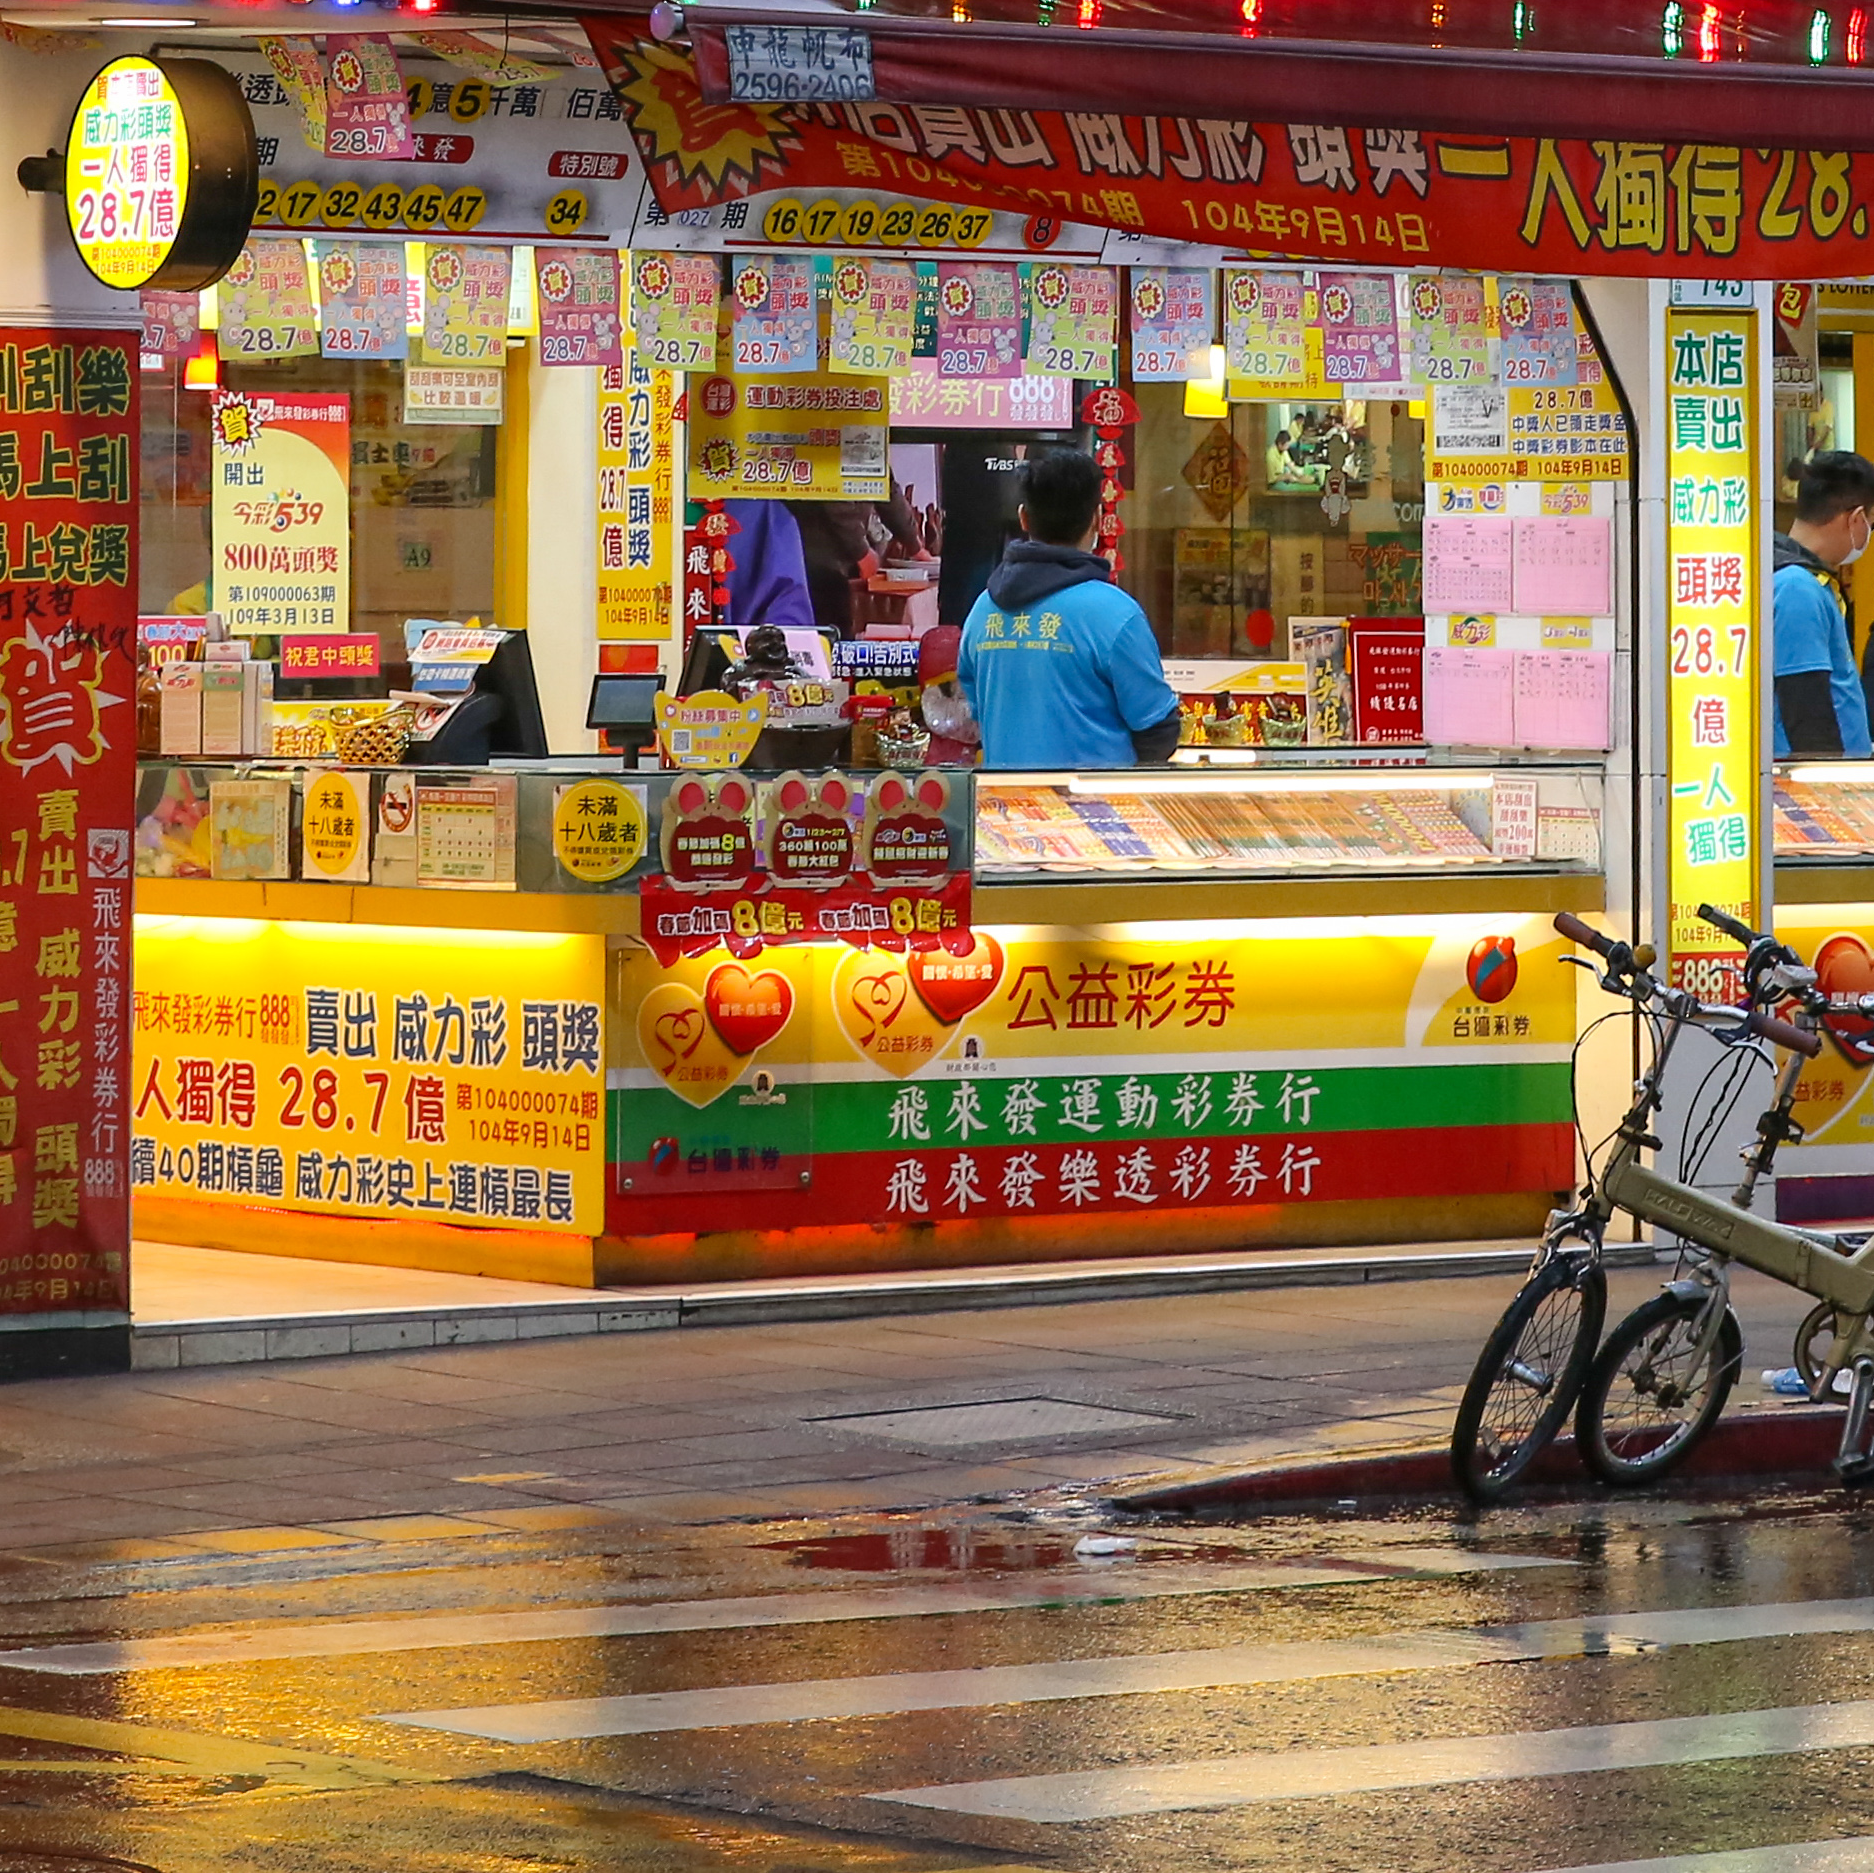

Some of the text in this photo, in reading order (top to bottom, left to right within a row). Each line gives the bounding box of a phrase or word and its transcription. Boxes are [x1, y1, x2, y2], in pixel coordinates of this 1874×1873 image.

[83, 106, 173, 146] 威力彩頭獎
[559, 153, 620, 178] 特別號
[77, 188, 176, 240] 28.7億
[326, 186, 581, 226] 32 43 45 47 34
[1672, 331, 1745, 388] 本店
[746, 387, 881, 412] 運動彩券投注處
[1672, 396, 1745, 454] 賣出
[223, 463, 265, 486] 開出
[1671, 478, 1746, 524] 威力彩
[223, 543, 339, 575] 800萬頭獎
[1676, 556, 1742, 604] 頭獎
[228, 586, 336, 604] 第109000063期
[228, 608, 334, 626] 109年3月13日
[984, 612, 1062, 640] 飛來發
[284, 644, 374, 668] 祝君中頭獎
[1672, 627, 1746, 674] 28.7
[577, 795, 618, 816] 未滿
[559, 821, 638, 843] 十八歲者
[1686, 815, 1746, 866] 獨得
[1005, 959, 1236, 1033] 公益彩券
[92, 886, 122, 1155] 飛來發彩券行
[305, 986, 600, 1074] 賣出 威力彩 頭獎
[1453, 1013, 1530, 1038] 台灣彩券
[134, 1056, 256, 1128] 人獨得
[887, 1072, 1322, 1142] 飛來發運動彩券行
[296, 1153, 574, 1223] 威力彩史上連槓最長
[886, 1144, 1323, 1214] 飛來發樂透彩券行
